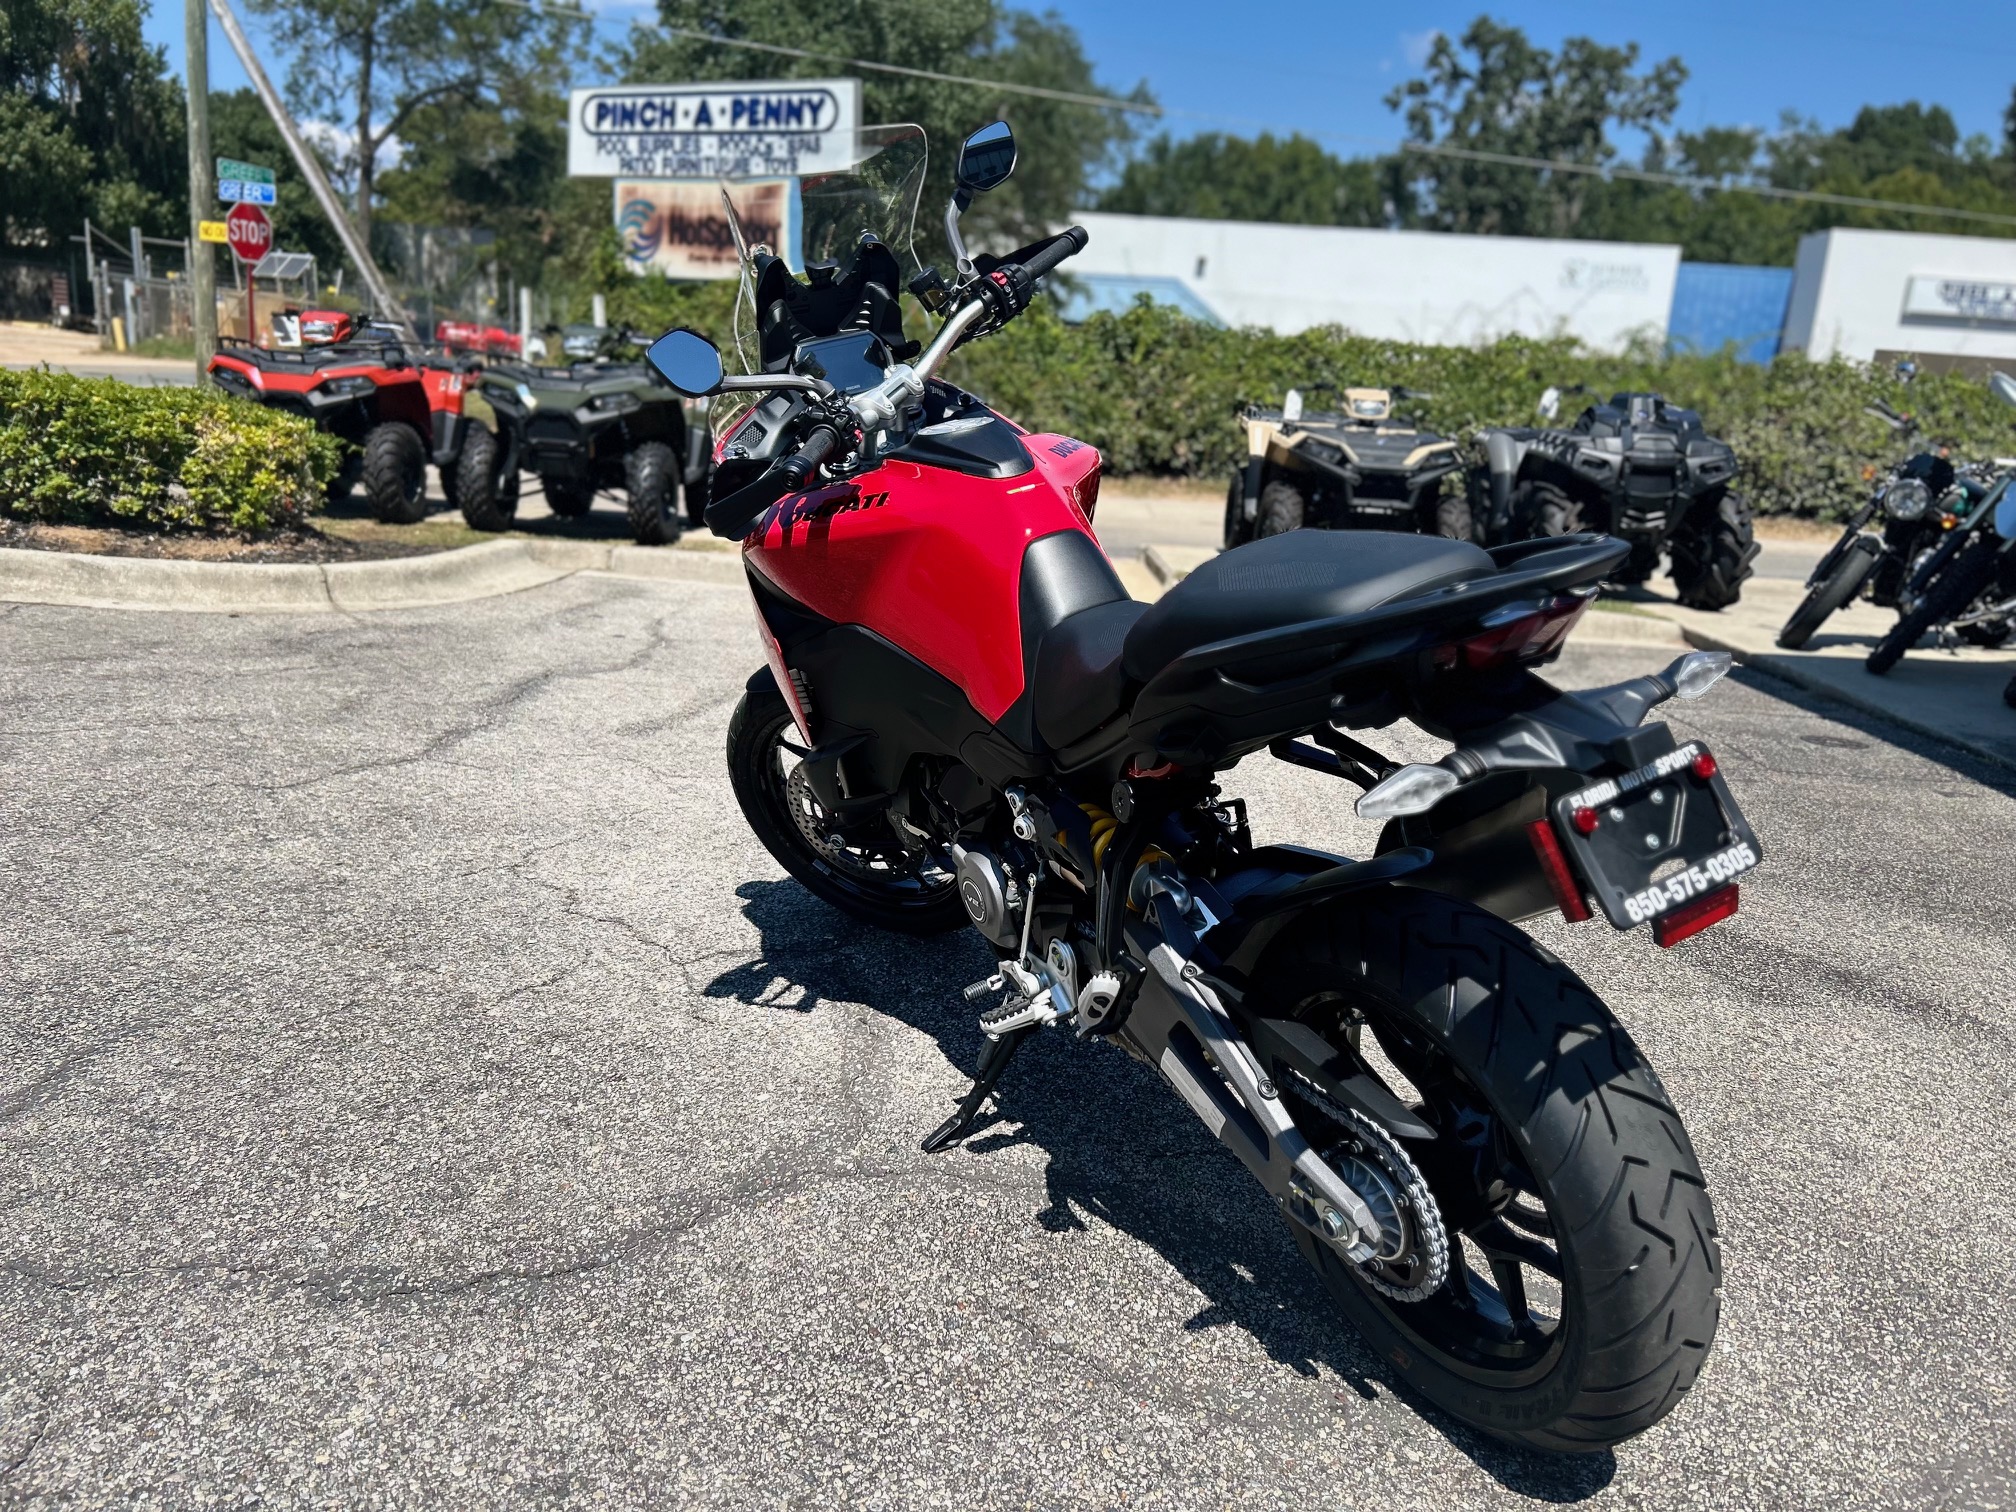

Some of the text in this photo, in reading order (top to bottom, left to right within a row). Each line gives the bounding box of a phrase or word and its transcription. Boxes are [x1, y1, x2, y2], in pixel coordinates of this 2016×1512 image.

[595, 97, 825, 128] PINCH A PENNY
[230, 218, 269, 245] STOP
[792, 491, 891, 525] DUCATI
[1569, 779, 1620, 809] FLORIDA
[1624, 842, 1757, 923] 850-575-0305
